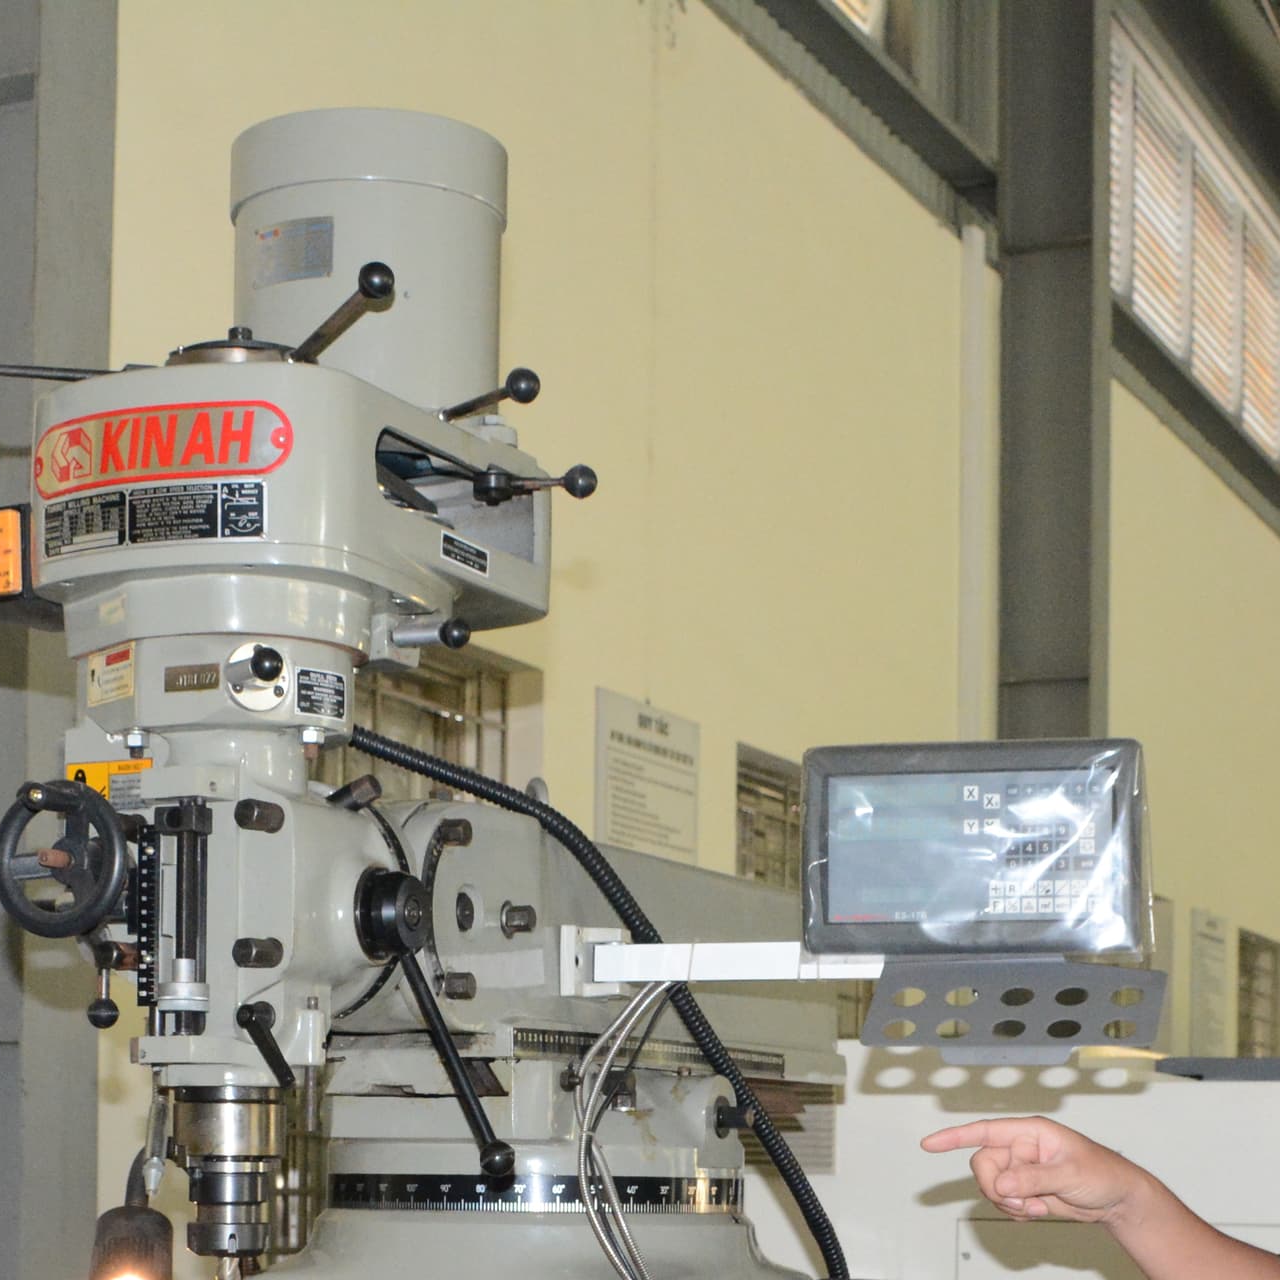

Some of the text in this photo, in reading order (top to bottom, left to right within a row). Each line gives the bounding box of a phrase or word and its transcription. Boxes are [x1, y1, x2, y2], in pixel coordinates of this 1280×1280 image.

[100, 410, 255, 474] KINAH
[967, 789, 975, 799] X
[966, 822, 975, 832] Y
[1025, 842, 1033, 852] 4
[440, 1183, 452, 1193] 90°
[513, 1183, 527, 1193] 70°
[552, 1184, 566, 1194] 60°
[590, 1184, 604, 1194] 5°
